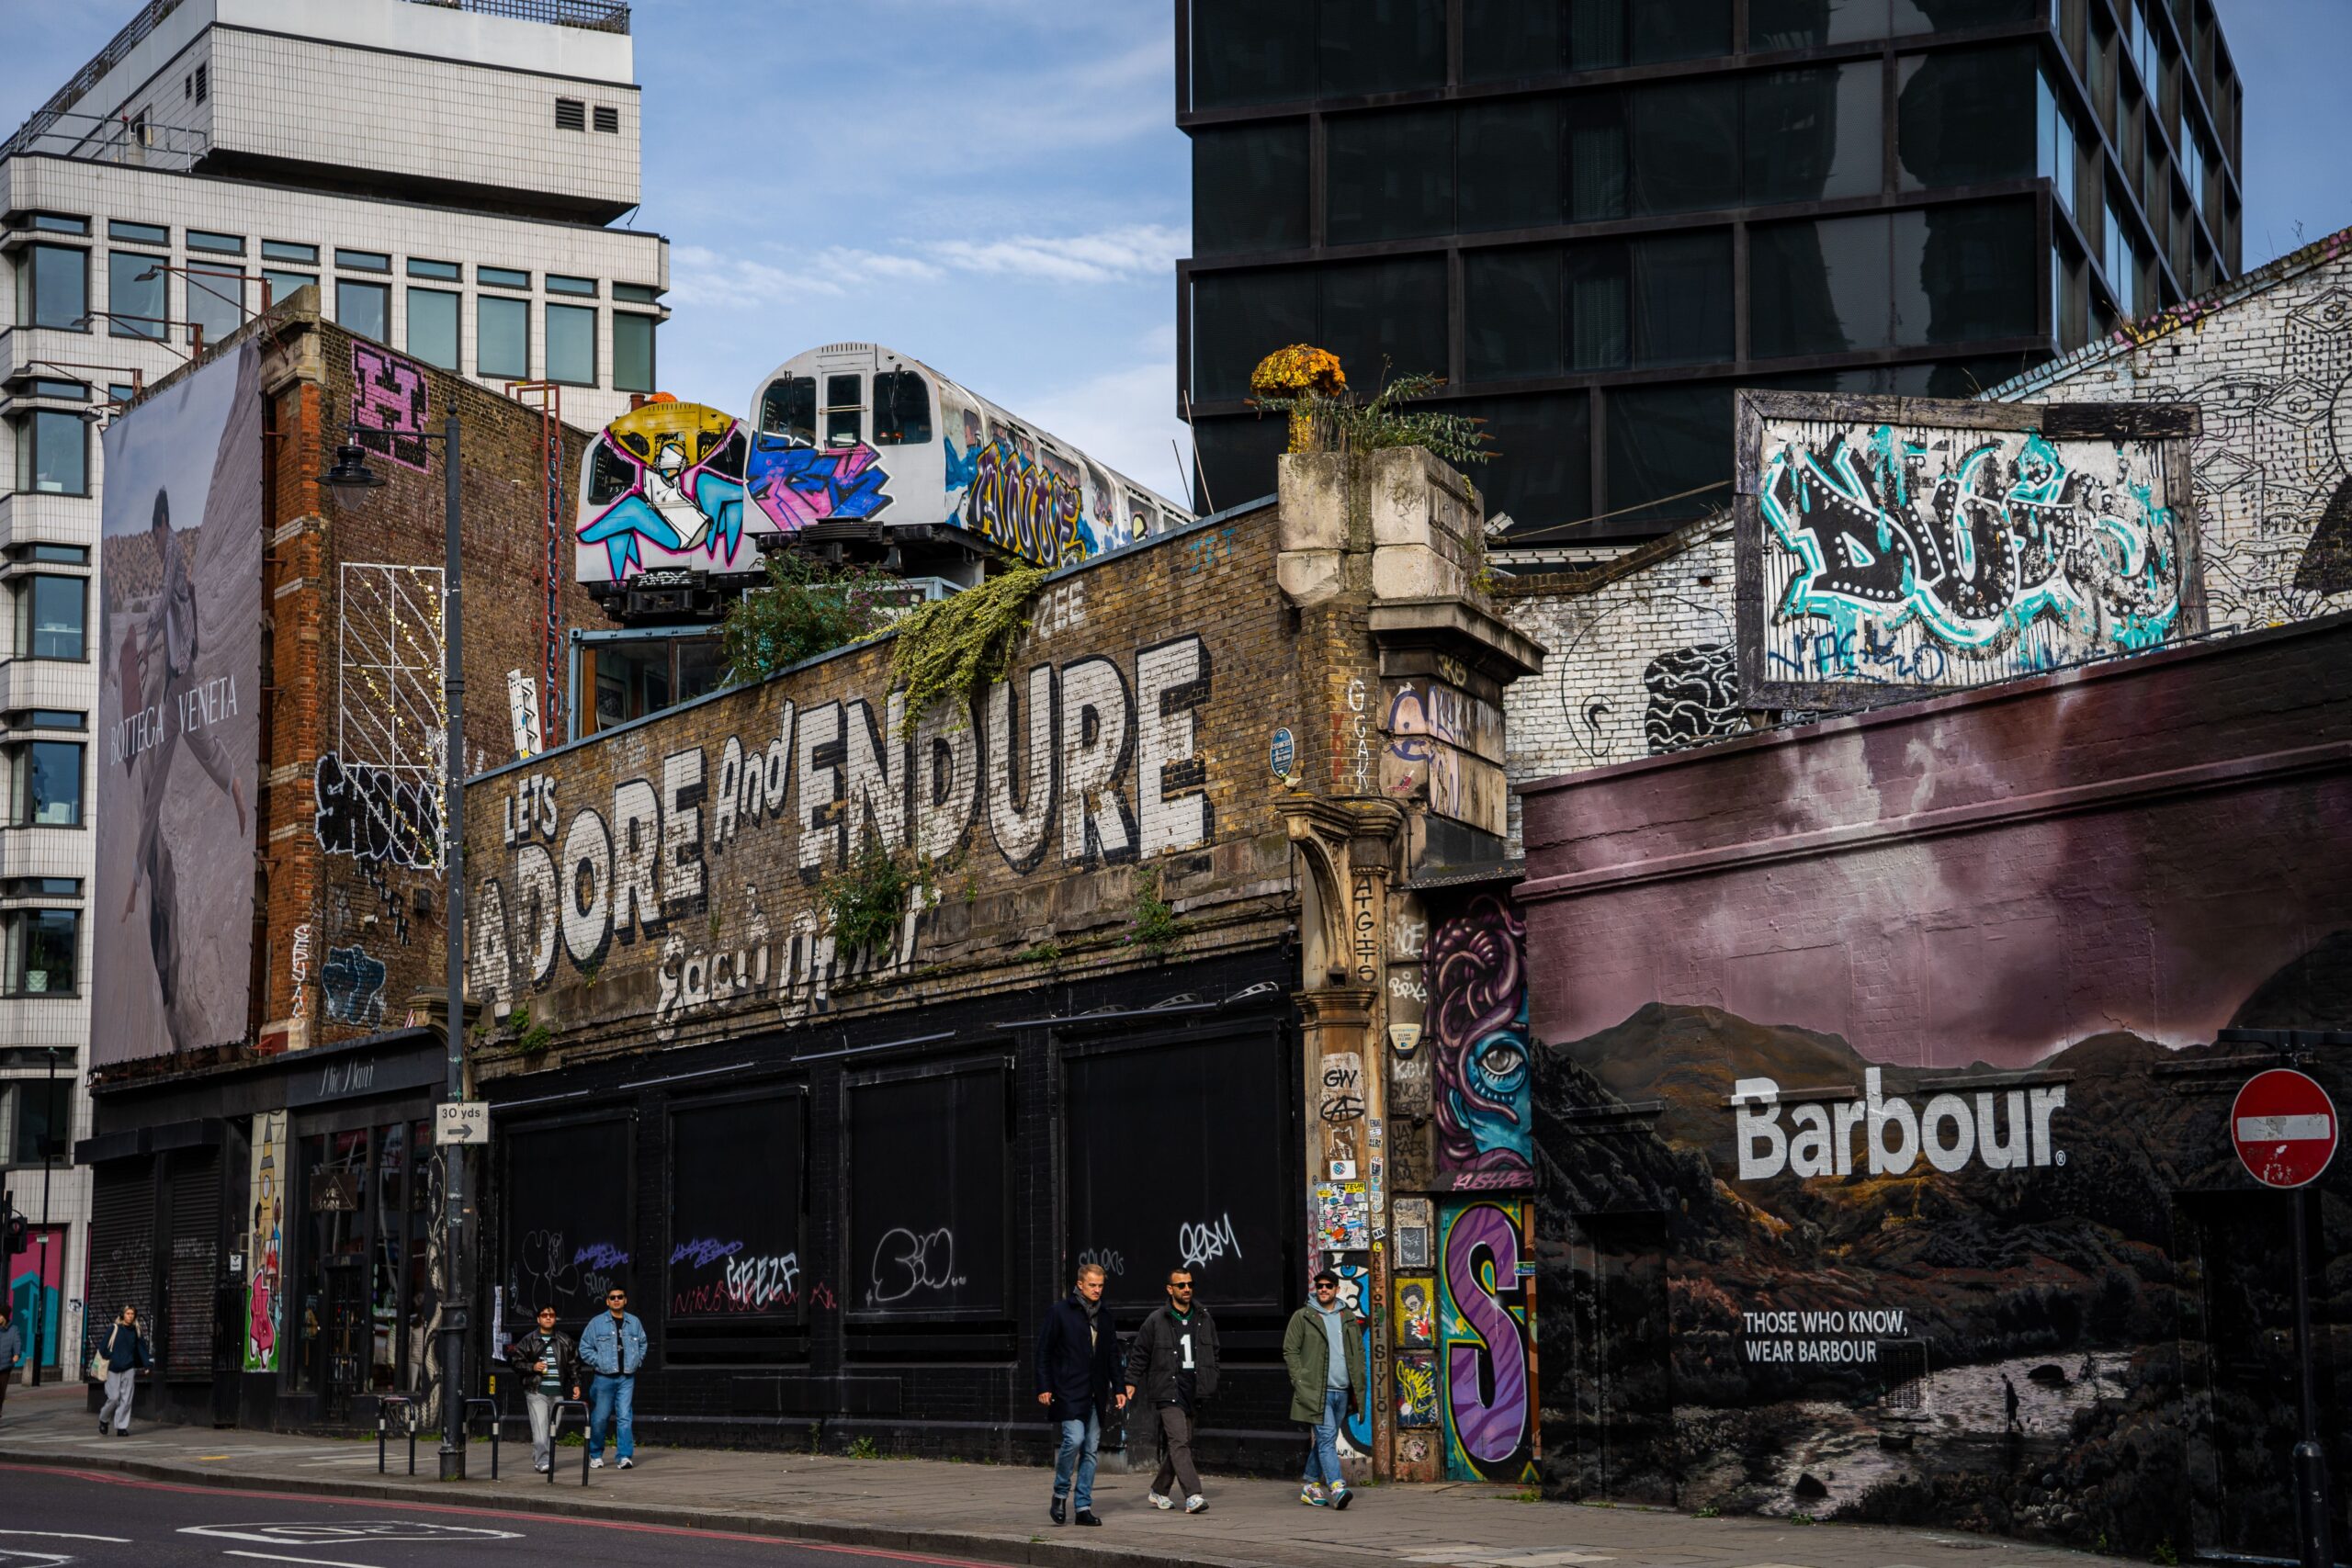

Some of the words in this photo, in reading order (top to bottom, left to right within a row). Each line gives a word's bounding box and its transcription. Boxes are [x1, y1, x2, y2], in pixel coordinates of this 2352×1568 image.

[110, 704, 165, 766] BOTTEGA
[178, 674, 239, 734] VENETA
[468, 745, 709, 1020] ADORE
[797, 633, 1215, 886] ENDURE
[504, 773, 559, 850] LETS
[442, 1108, 458, 1118] 30
[461, 1108, 481, 1120] yds
[1744, 1312, 1797, 1334] THOSE
[1802, 1312, 1844, 1334] WHO
[1849, 1310, 1908, 1337] KNOW,
[1180, 1334, 1195, 1370] 1
[1746, 1340, 1794, 1362] WEAR
[1799, 1339, 1877, 1363] BARBOUR
